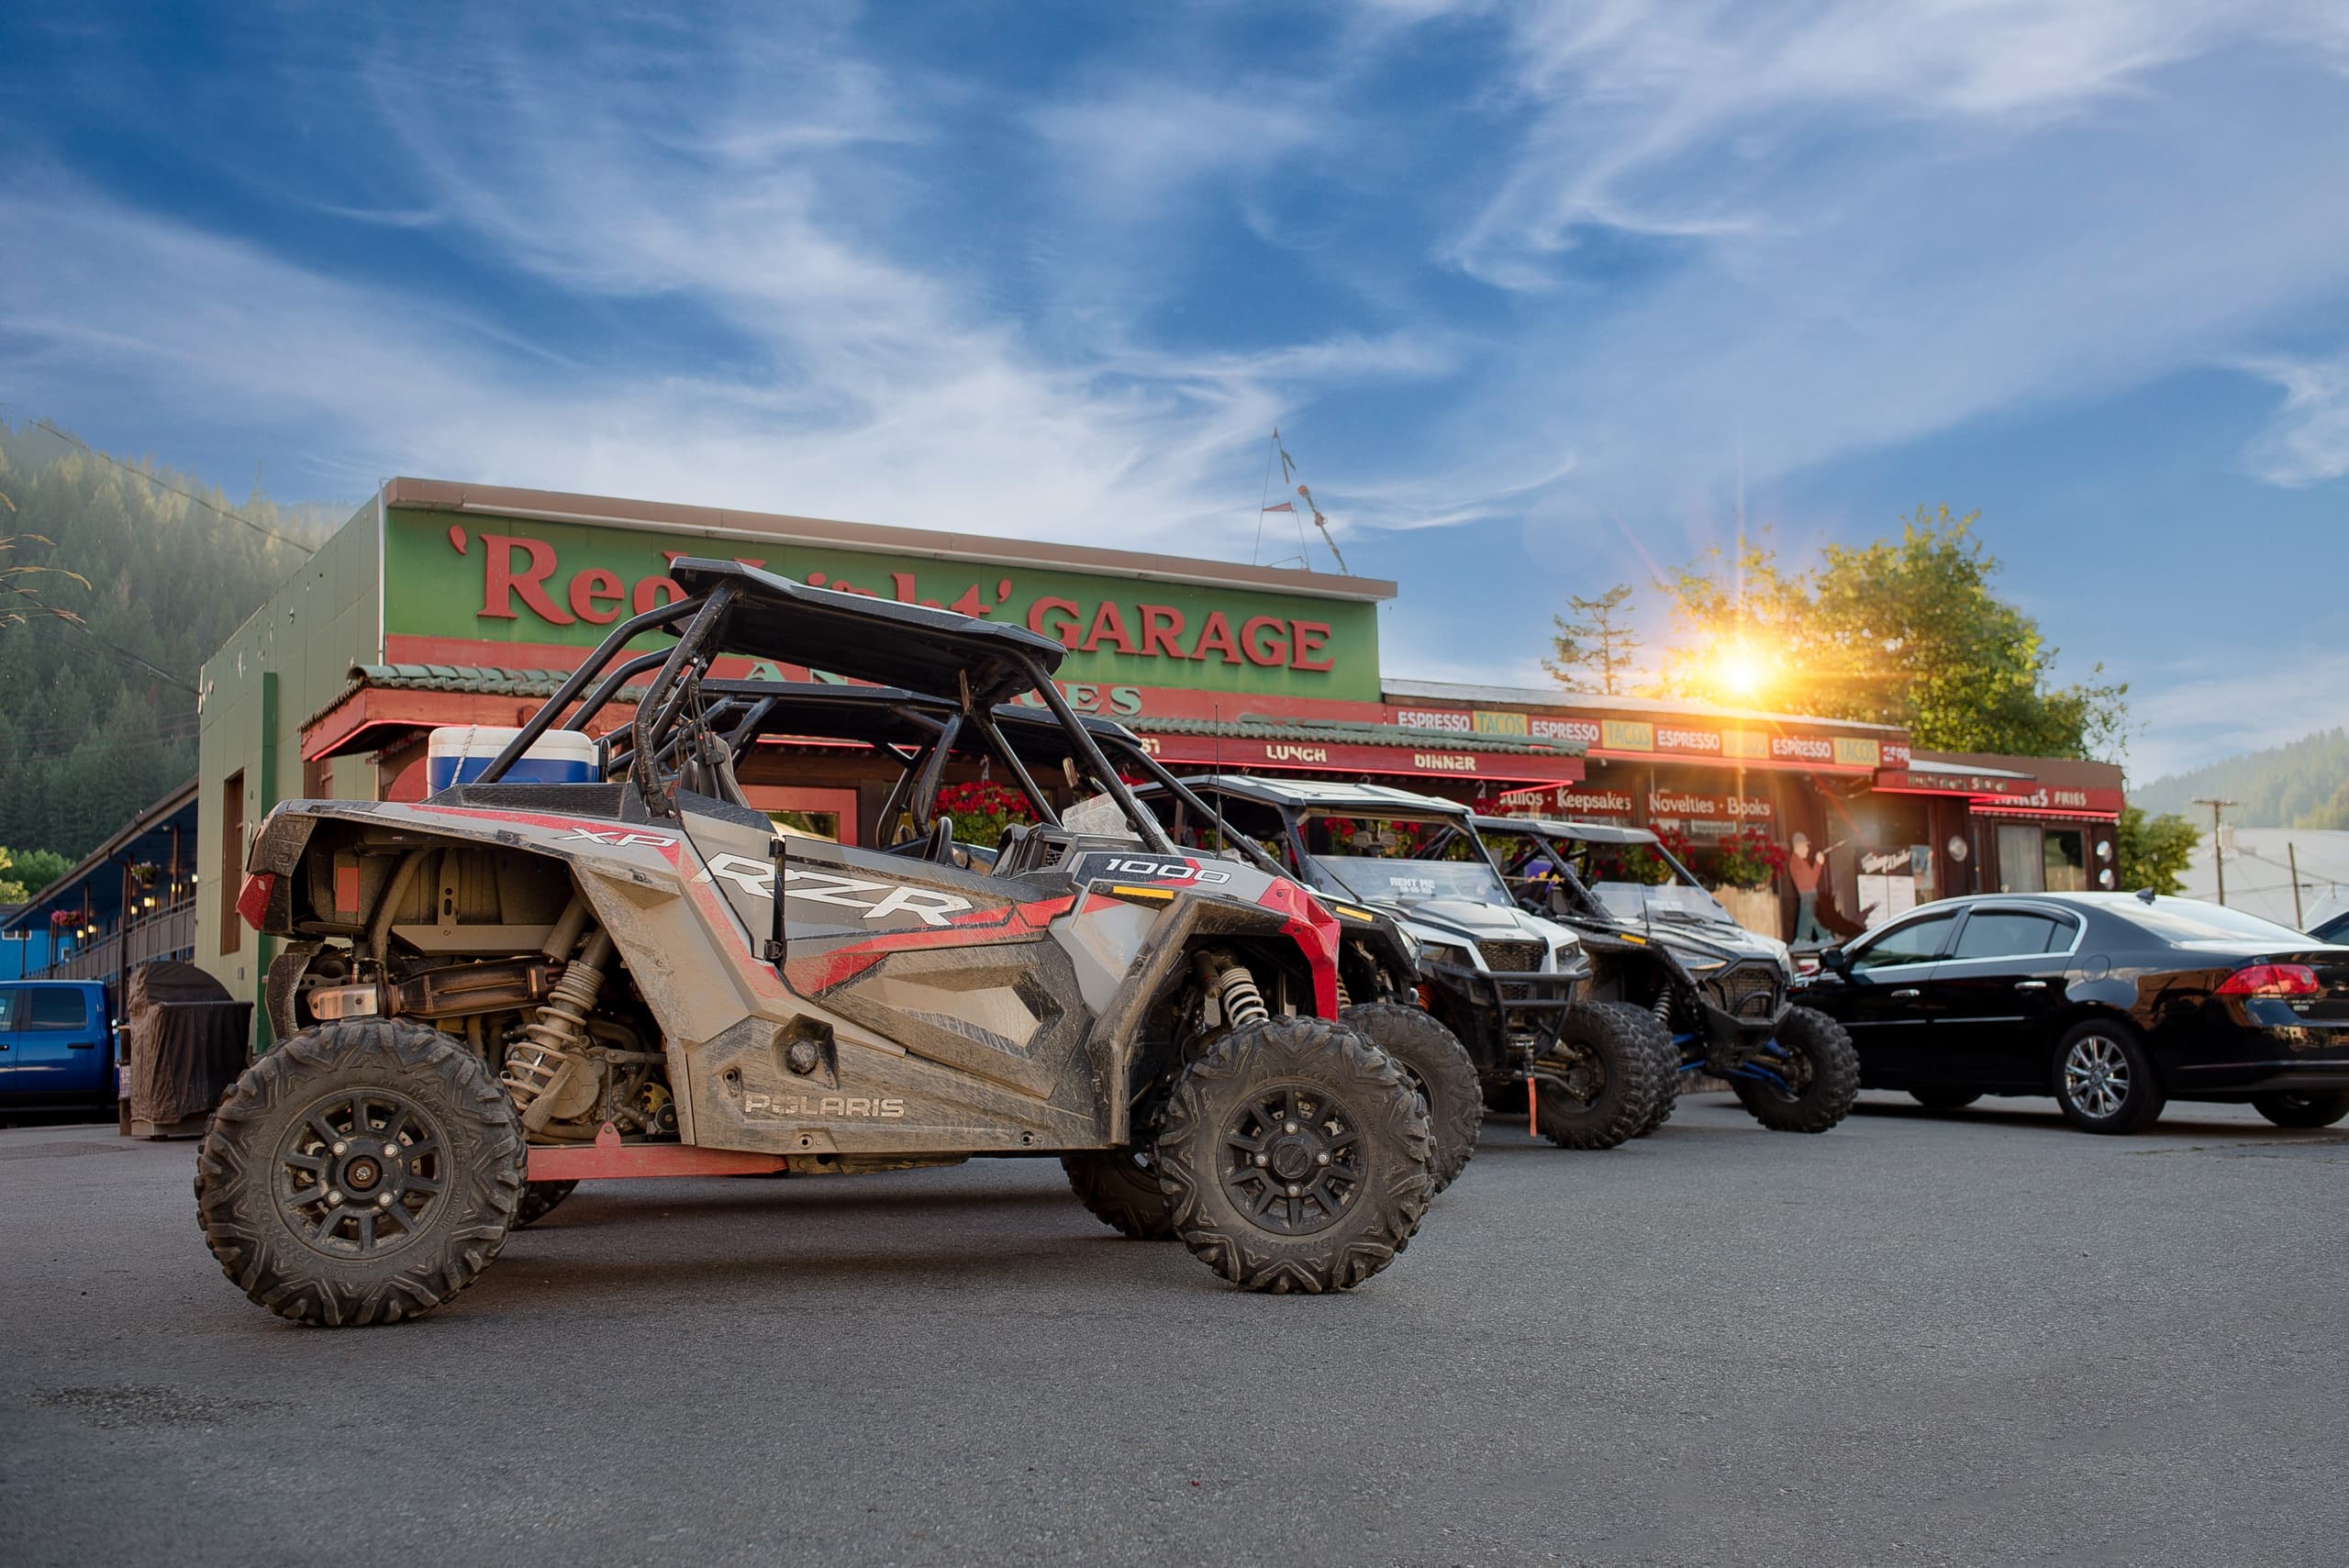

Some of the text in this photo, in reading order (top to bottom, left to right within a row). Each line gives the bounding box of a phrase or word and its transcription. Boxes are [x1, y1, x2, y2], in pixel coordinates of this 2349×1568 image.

[1028, 596, 1335, 672] GARAGE
[1397, 710, 1470, 733] ESPRESSO
[1475, 712, 1526, 735] TACOS
[1531, 720, 1599, 741] ESPRESSO
[1605, 721, 1652, 747] TACOS
[1657, 729, 1720, 751] ESPRESSO
[1265, 744, 1328, 763] LUNCH
[1772, 737, 1831, 759] ESPRESSO
[1838, 740, 1877, 762] TACOS
[1414, 753, 1475, 771] DINNER
[1556, 786, 1632, 813] Keepsakes
[1649, 794, 1771, 817] Novelties Books
[550, 827, 680, 848] XP
[1106, 858, 1232, 885] 1000
[681, 851, 974, 926] RZR
[744, 1094, 906, 1118] POLARIS
